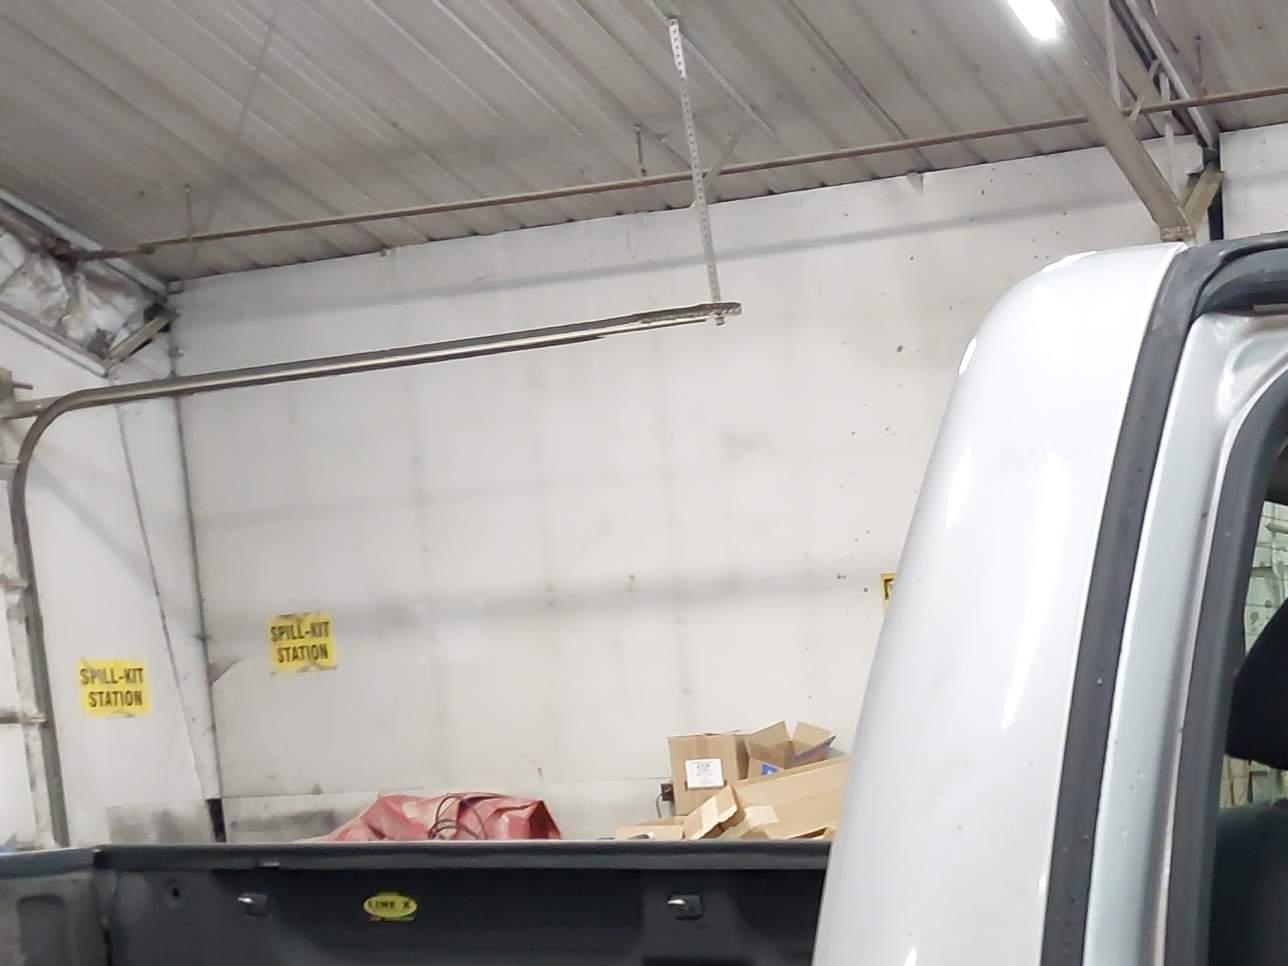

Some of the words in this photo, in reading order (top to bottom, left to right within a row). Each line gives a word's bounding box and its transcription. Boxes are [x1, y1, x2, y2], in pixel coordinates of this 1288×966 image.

[270, 621, 329, 642] SPILL-KIT
[277, 643, 328, 663] STATION
[80, 667, 144, 685] SPILL-KIT
[88, 690, 143, 708] STATION
